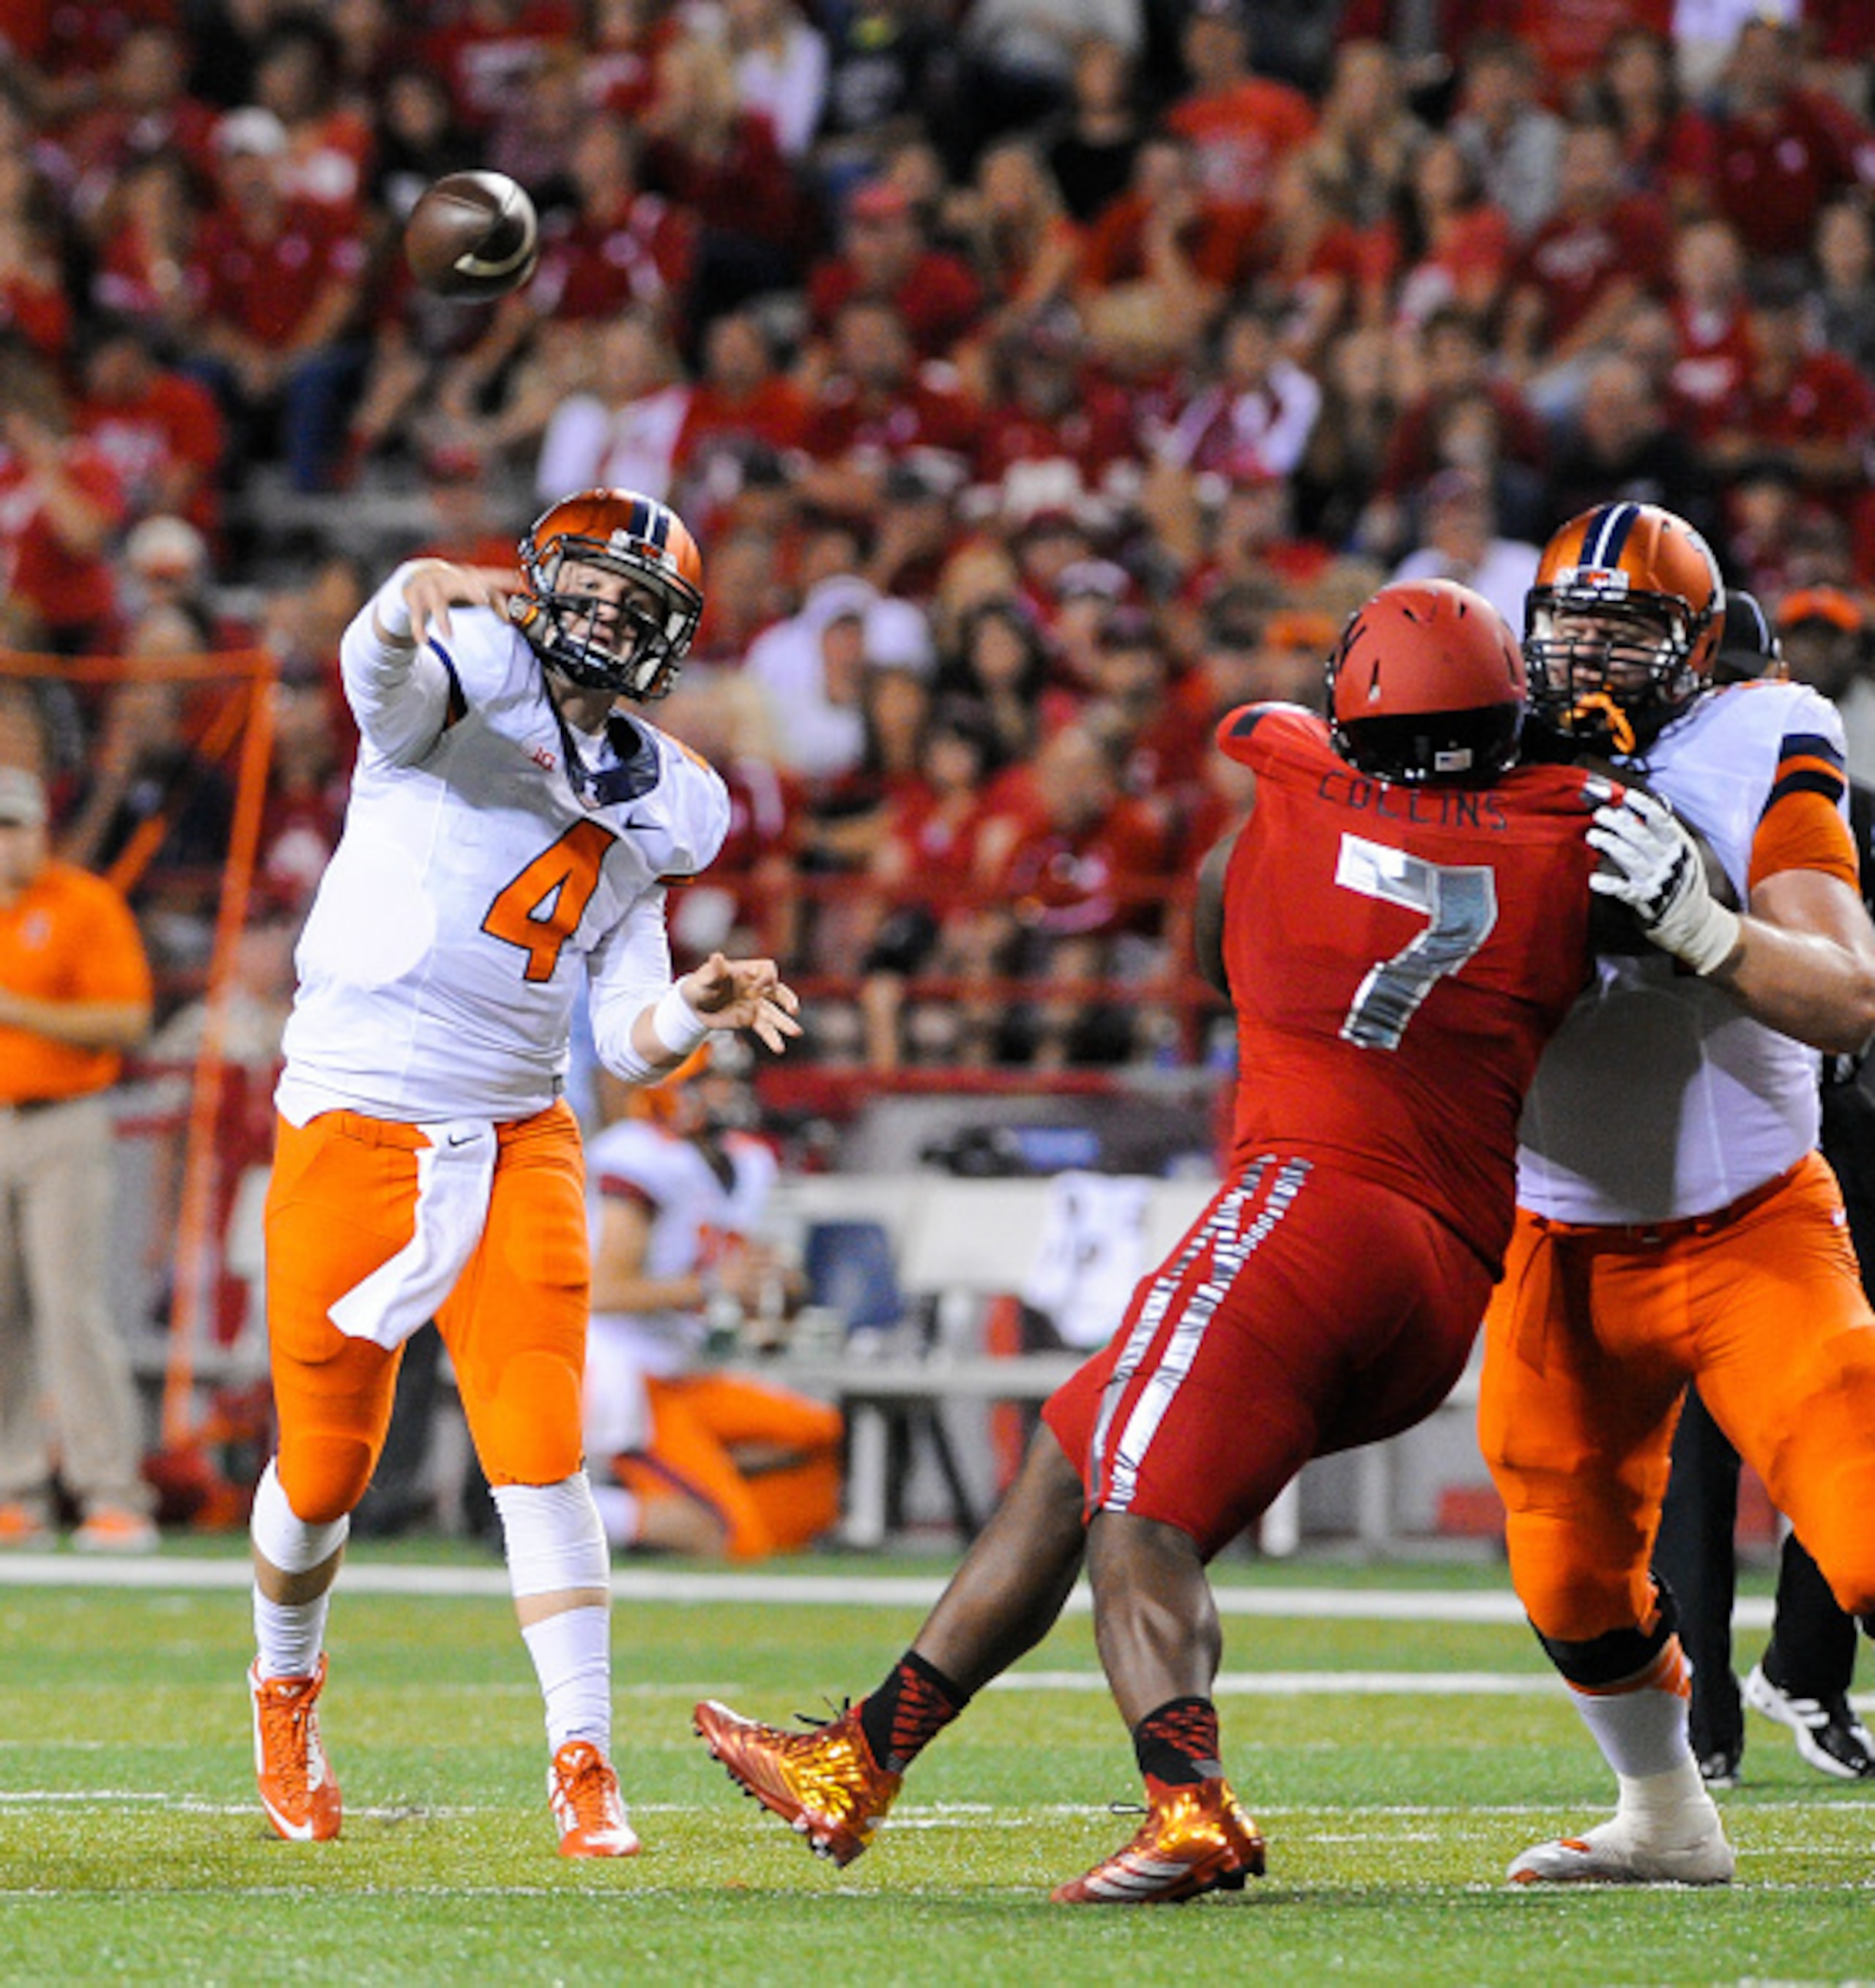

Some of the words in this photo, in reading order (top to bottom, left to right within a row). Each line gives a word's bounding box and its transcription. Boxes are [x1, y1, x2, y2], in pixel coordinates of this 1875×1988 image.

[1319, 770, 1506, 830] COLLINS
[480, 817, 619, 983] 4
[1334, 831, 1498, 1049] 7
